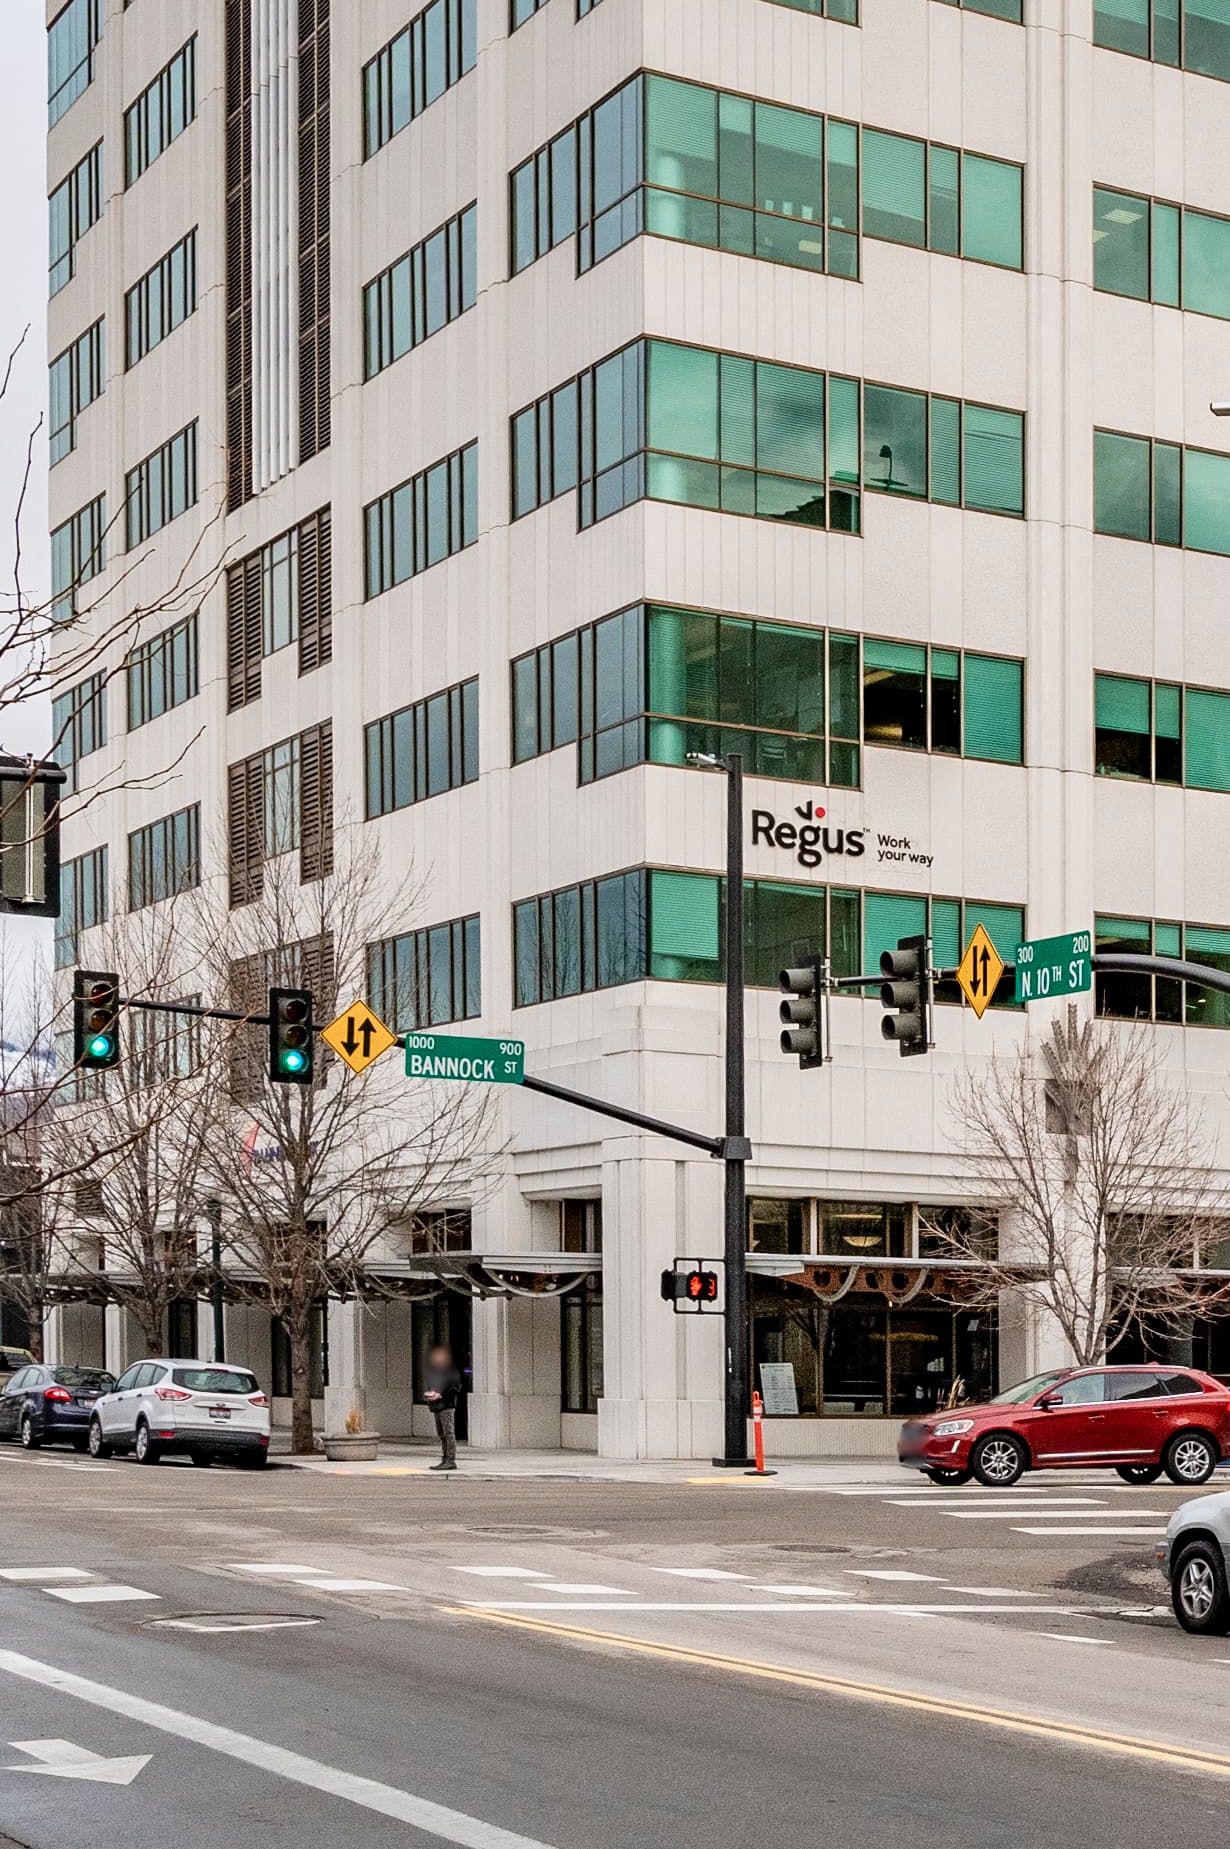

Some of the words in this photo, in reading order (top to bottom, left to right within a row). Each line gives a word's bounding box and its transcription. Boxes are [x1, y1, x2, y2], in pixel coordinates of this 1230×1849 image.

[751, 807, 865, 868] Regus
[877, 833, 911, 850] Work
[877, 849, 907, 863] your
[908, 854, 935, 868] way
[1017, 945, 1034, 964] 300
[1072, 934, 1090, 954] 200
[1068, 959, 1085, 989] ST
[408, 1035, 435, 1050] 1000
[499, 1042, 522, 1056] 900
[410, 1054, 496, 1080] BANNOCK
[504, 1061, 518, 1074] ST
